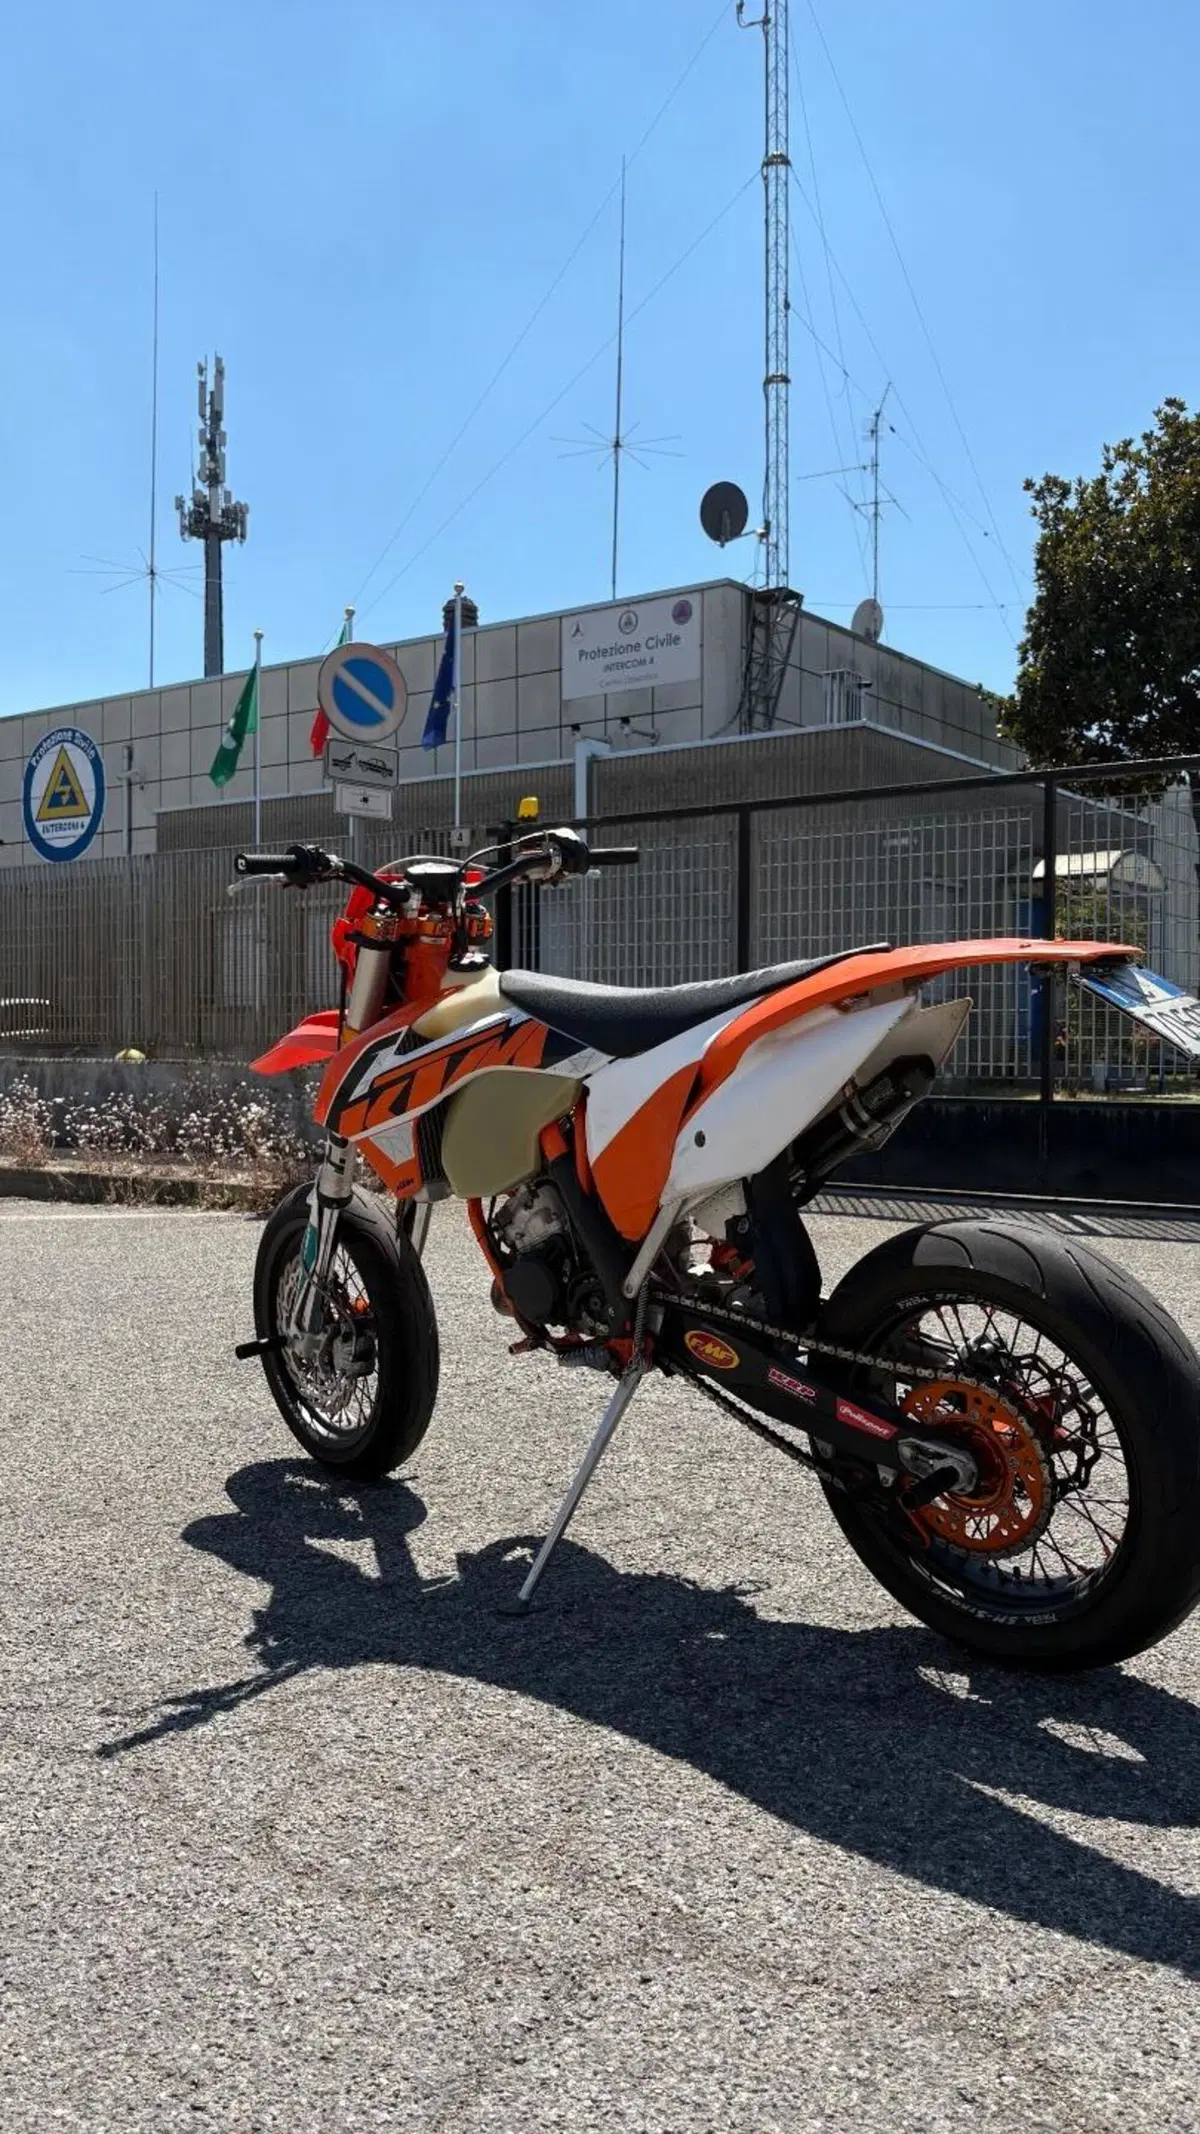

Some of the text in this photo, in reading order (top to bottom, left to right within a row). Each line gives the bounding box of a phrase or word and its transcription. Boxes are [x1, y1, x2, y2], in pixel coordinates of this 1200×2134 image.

[578, 632, 682, 662] Protezione Civile
[603, 658, 647, 673] INTERCOM
[31, 730, 97, 767] Protezione Civile
[42, 820, 79, 834] INTERCOM
[340, 1018, 549, 1136] KTM
[396, 1178, 415, 1190] KTM
[689, 1337, 733, 1361] FMF
